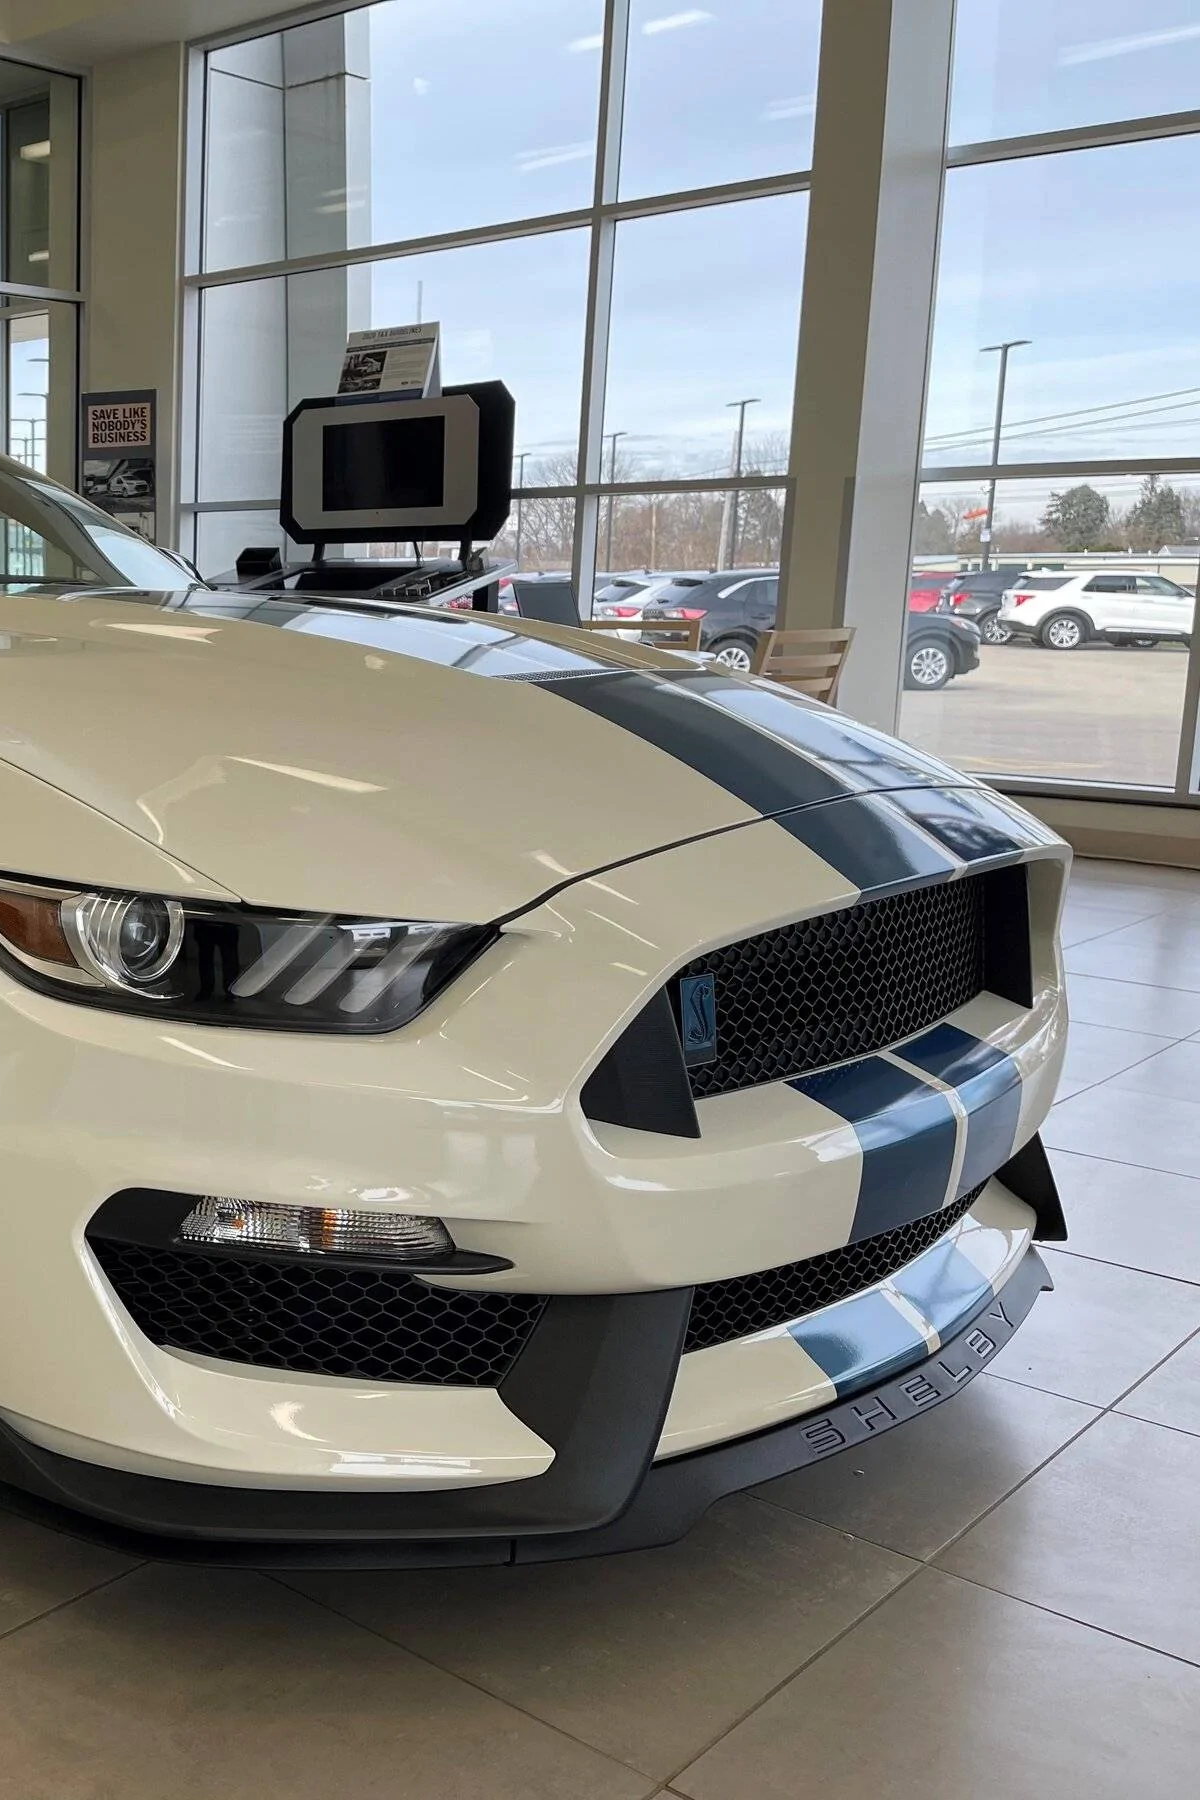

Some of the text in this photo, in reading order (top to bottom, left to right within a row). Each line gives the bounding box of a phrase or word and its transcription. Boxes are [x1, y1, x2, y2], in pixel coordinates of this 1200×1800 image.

[92, 406, 147, 421] SAVE LIKE
[92, 418, 147, 432] NOBODY'S
[92, 430, 147, 444] BUSINESS
[800, 1300, 1015, 1454] SHELBY
